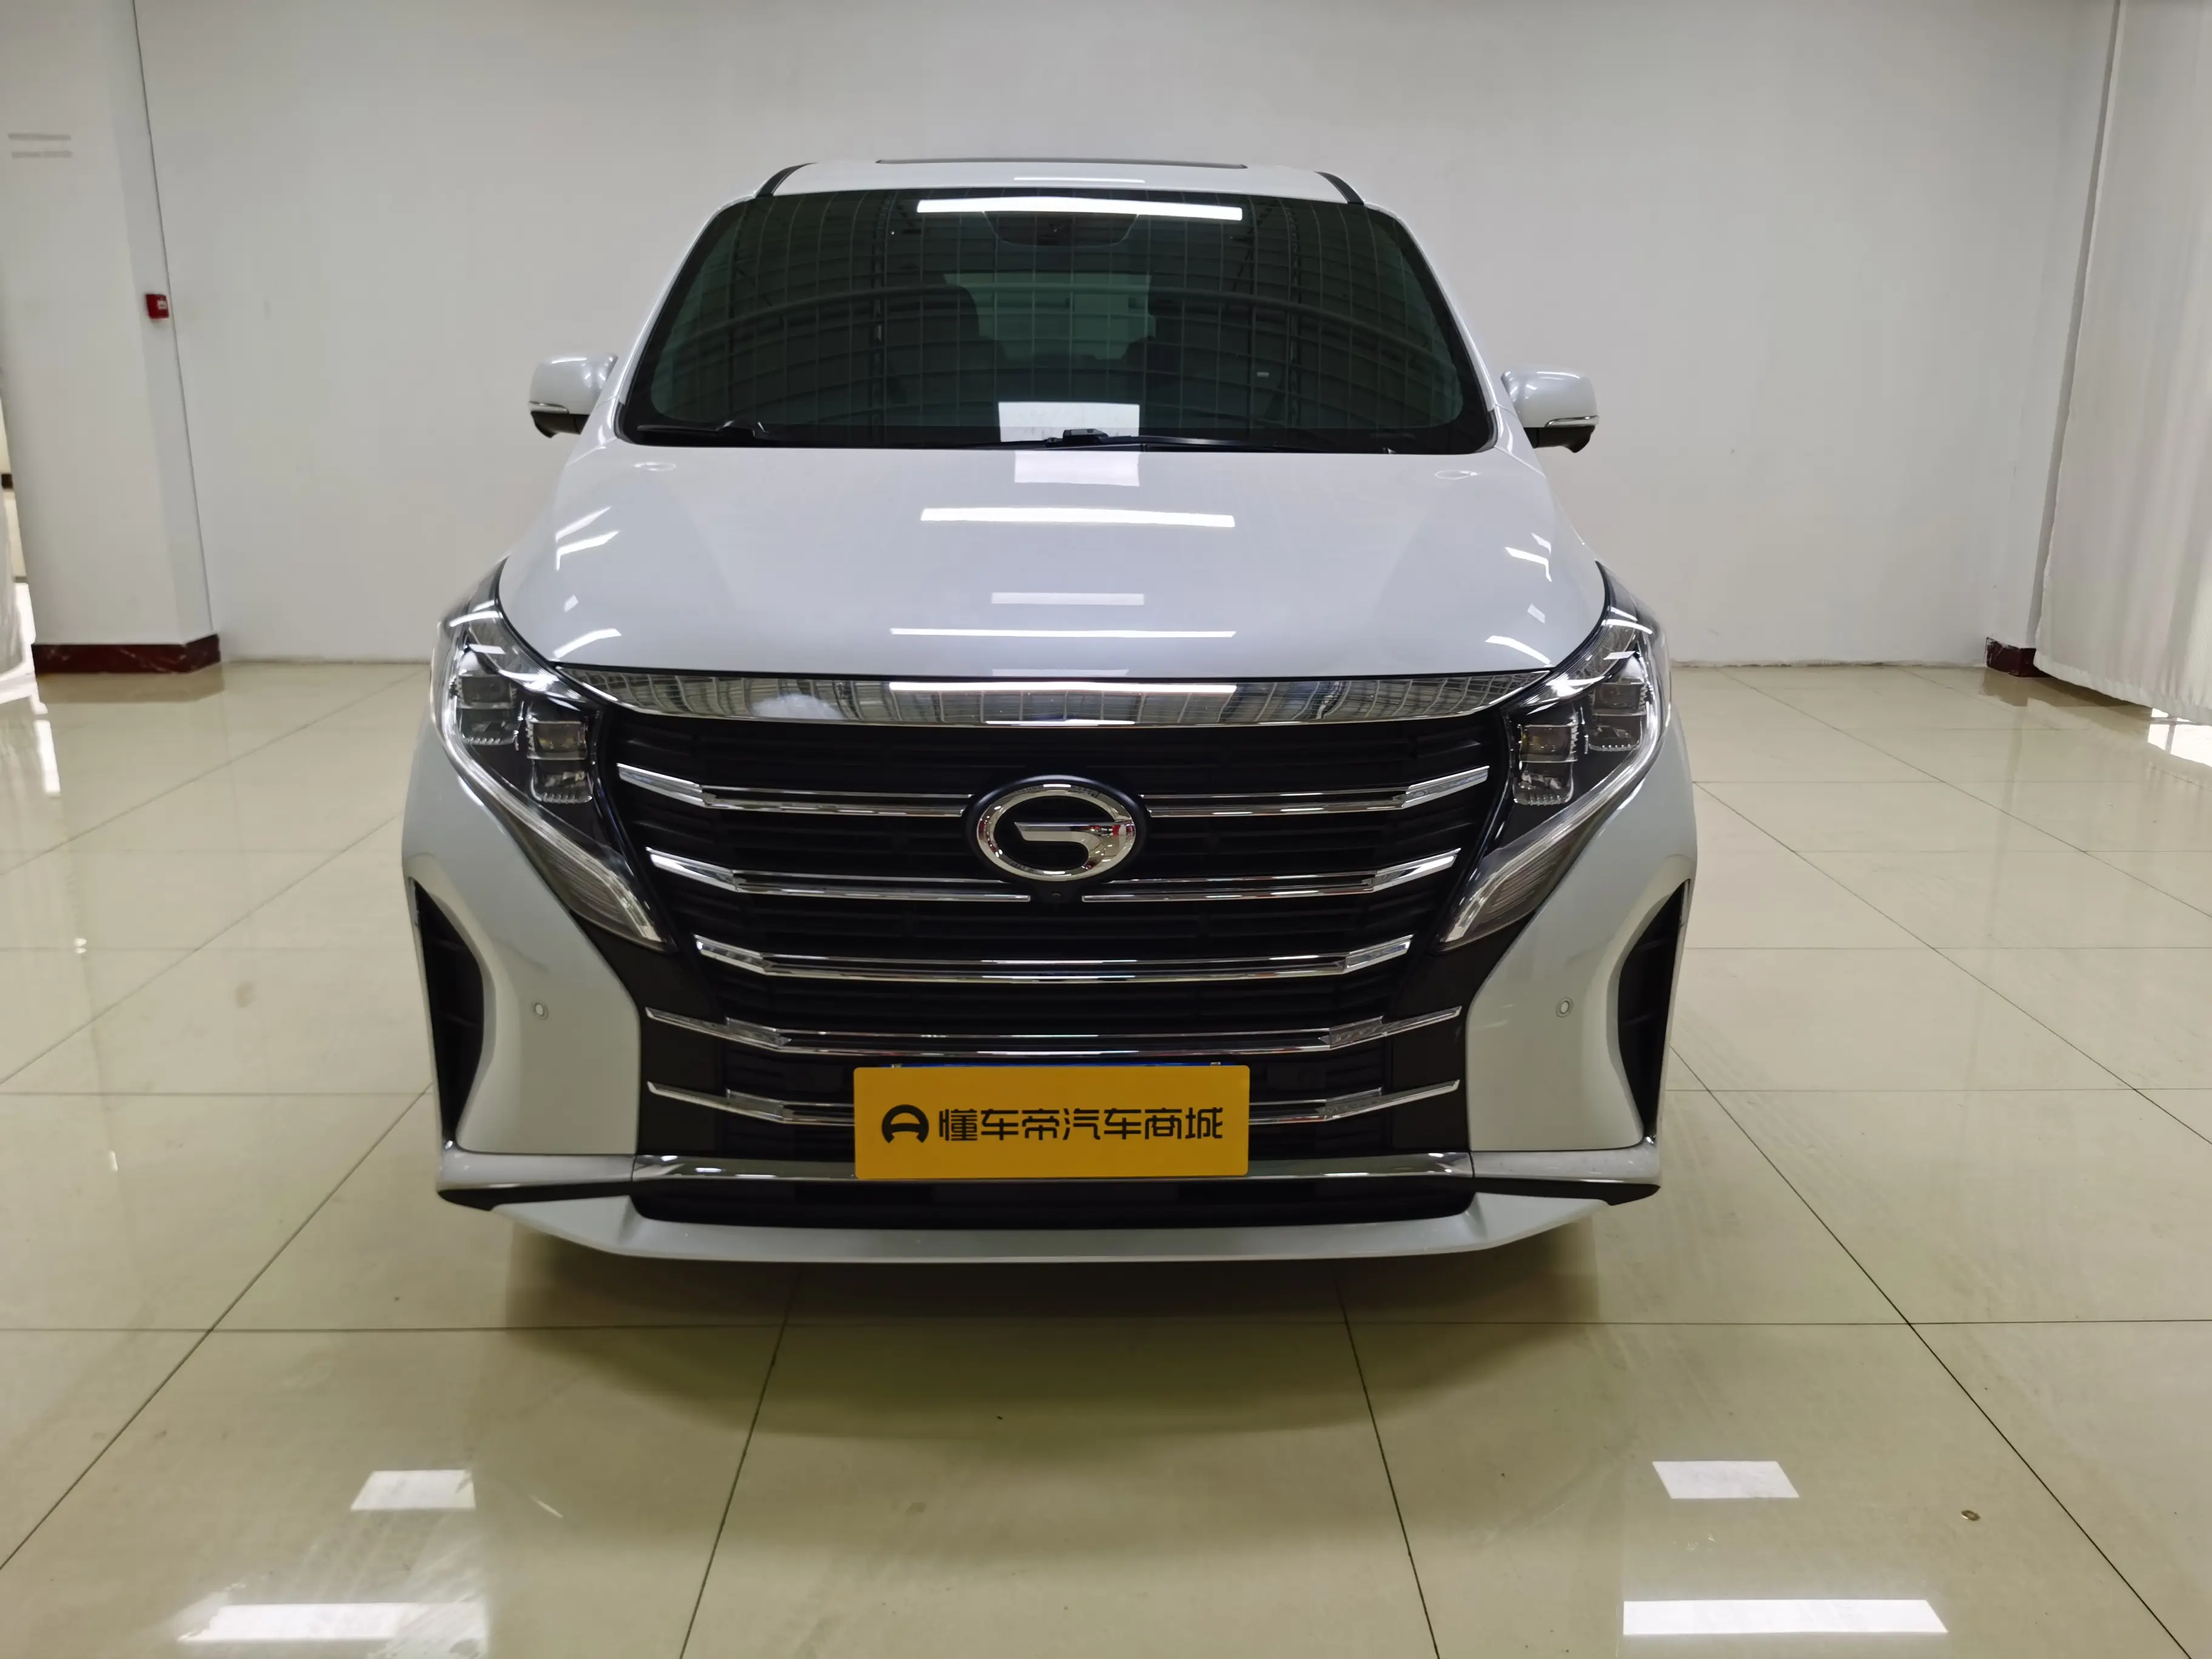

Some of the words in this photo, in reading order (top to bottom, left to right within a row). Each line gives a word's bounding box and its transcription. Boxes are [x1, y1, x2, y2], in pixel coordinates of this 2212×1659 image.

[939, 1107, 1224, 1141] 懂车帝汽车商城
